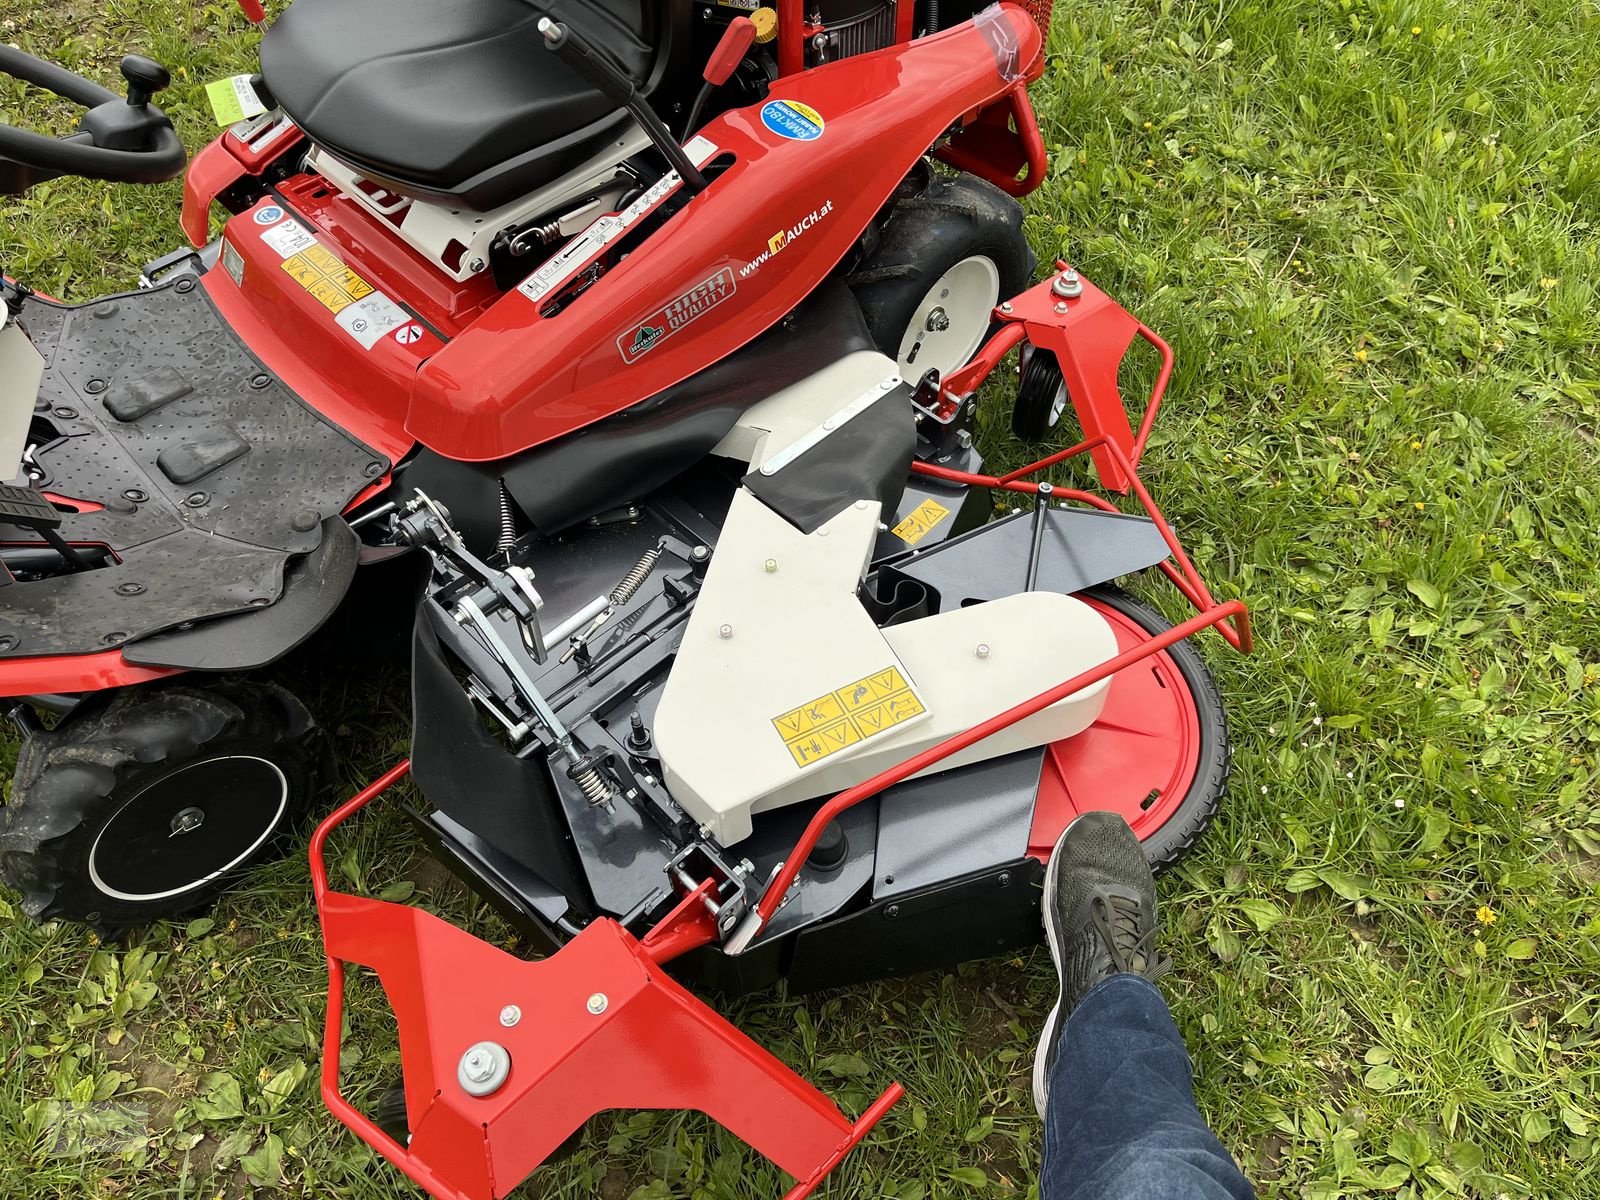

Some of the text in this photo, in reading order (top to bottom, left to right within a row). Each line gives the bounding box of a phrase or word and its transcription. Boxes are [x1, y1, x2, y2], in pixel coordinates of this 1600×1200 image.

[763, 107, 810, 139] RMK180
[773, 102, 797, 119] MOWER
[795, 118, 819, 134] RABBIT
[740, 200, 833, 277] www.MAUCH.at
[664, 274, 724, 319] HIGH
[668, 285, 726, 329] QUALITY
[630, 327, 663, 353] Herkules
